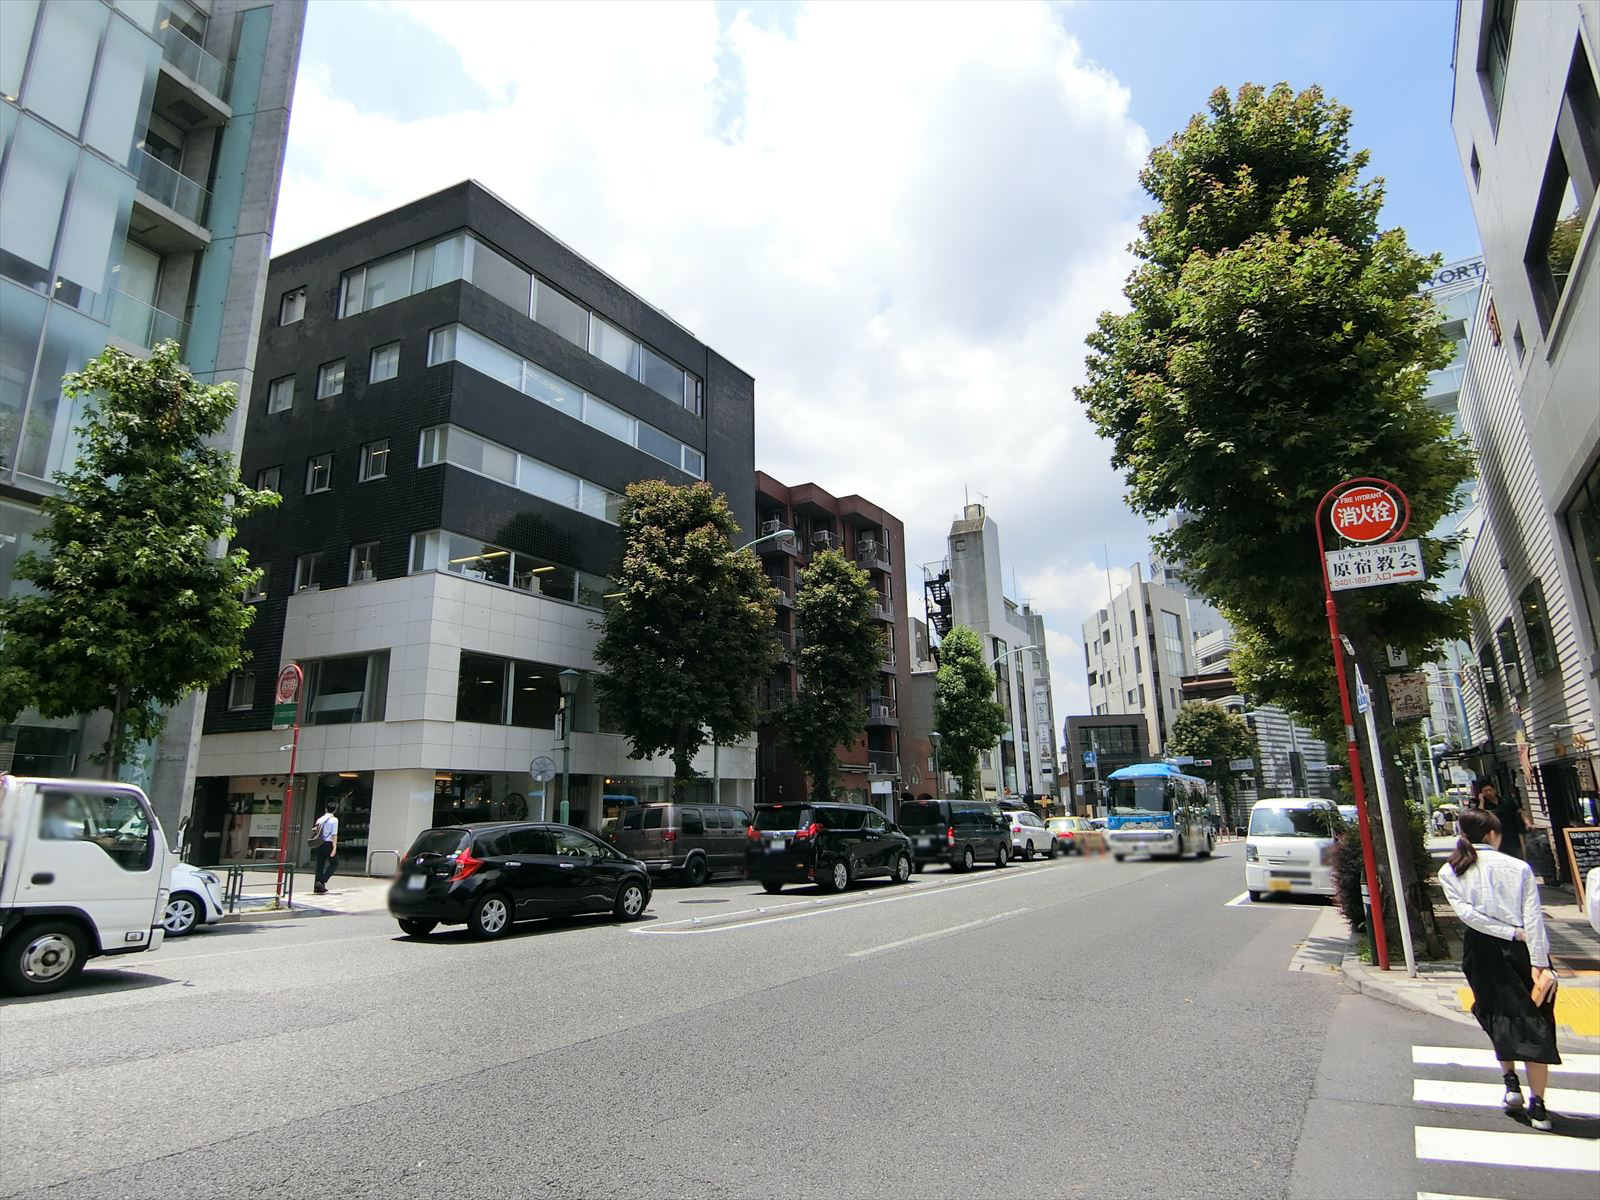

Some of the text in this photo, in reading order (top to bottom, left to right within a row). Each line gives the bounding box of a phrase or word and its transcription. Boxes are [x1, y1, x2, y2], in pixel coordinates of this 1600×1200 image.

[1340, 492, 1382, 504] FIRE HYDRANT
[1337, 500, 1393, 528] 消火栓
[1338, 545, 1407, 560] 日本キリスト教団
[1333, 552, 1417, 577] 原宿教会
[1374, 572, 1392, 582] 入口
